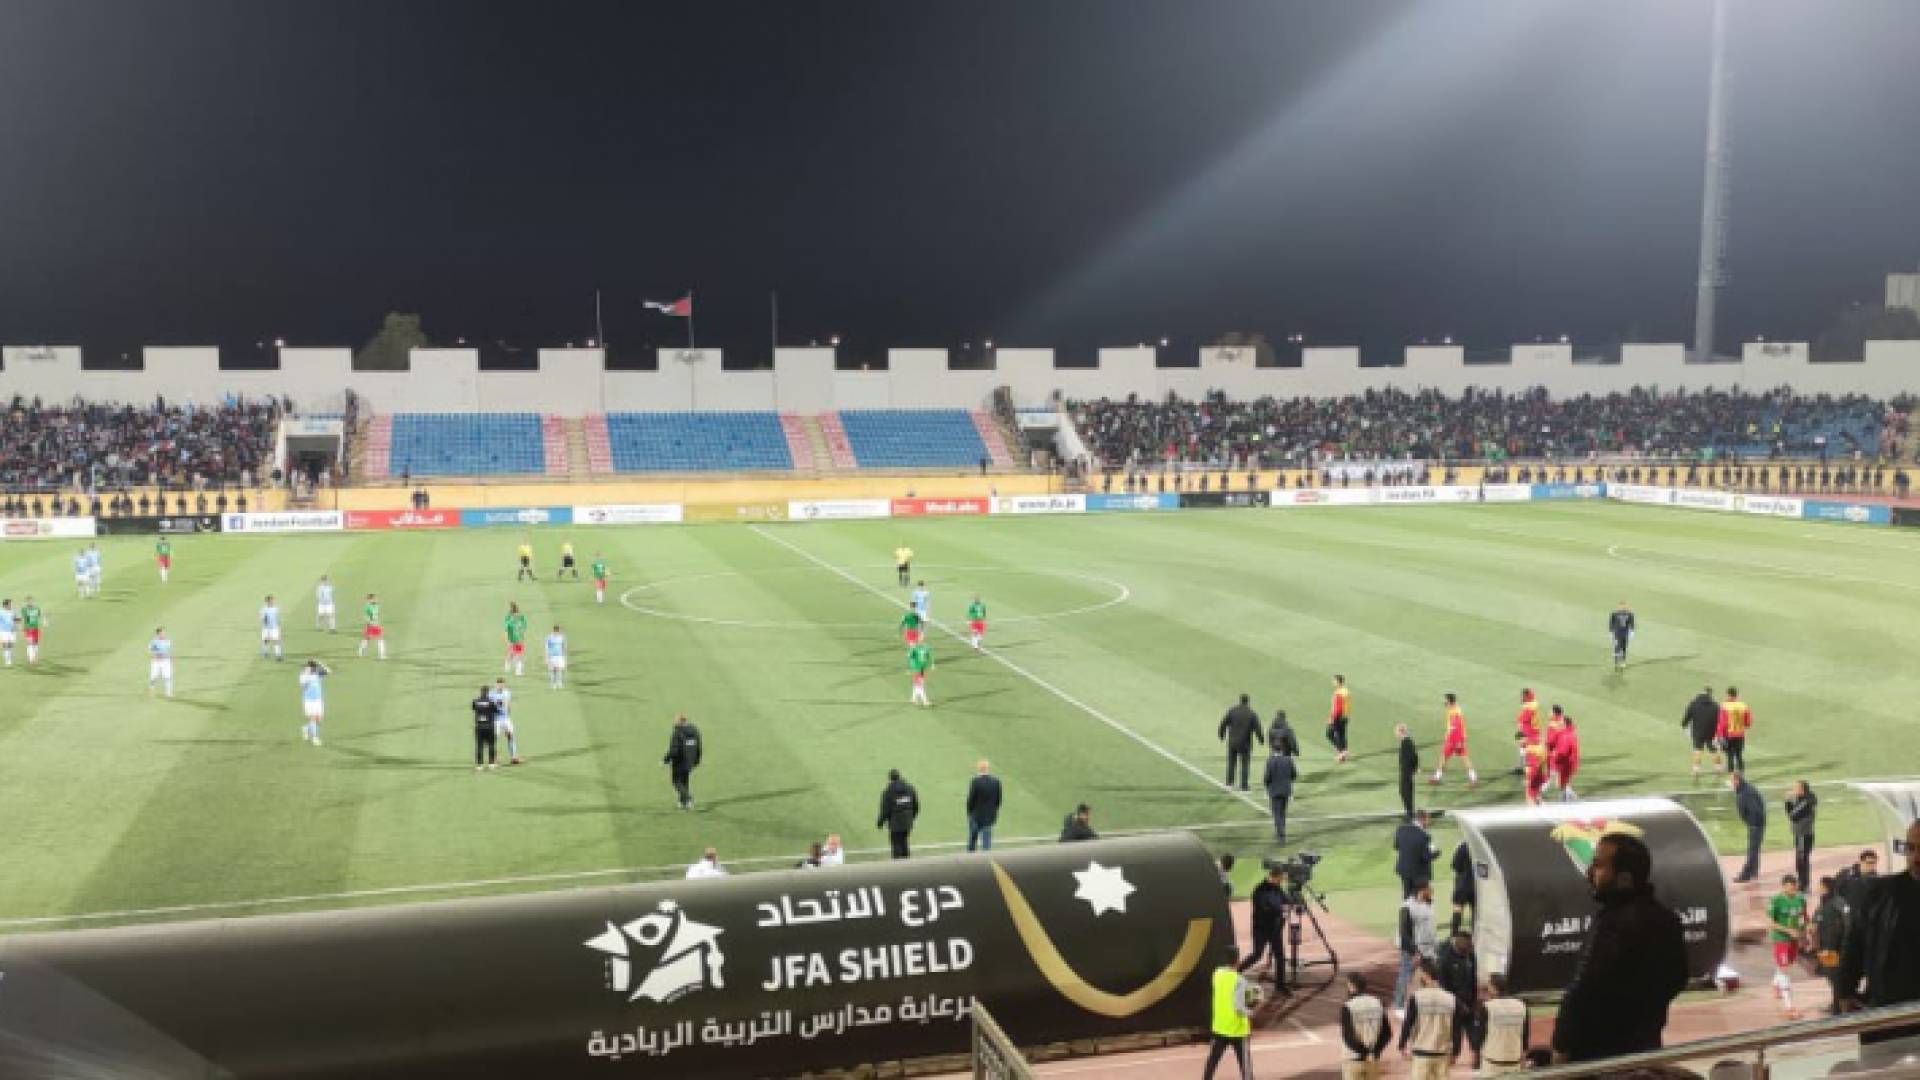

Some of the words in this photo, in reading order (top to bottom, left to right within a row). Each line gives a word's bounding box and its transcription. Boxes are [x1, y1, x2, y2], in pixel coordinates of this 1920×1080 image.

[756, 884, 887, 928] الاتحاد
[900, 884, 965, 927] درع
[761, 951, 833, 992] JFA
[838, 936, 975, 983] SHIELD
[701, 1009, 793, 1049] التربية
[800, 1002, 892, 1040] مدارس
[898, 992, 977, 1025] برعاية
[587, 1019, 694, 1062] الريادية
